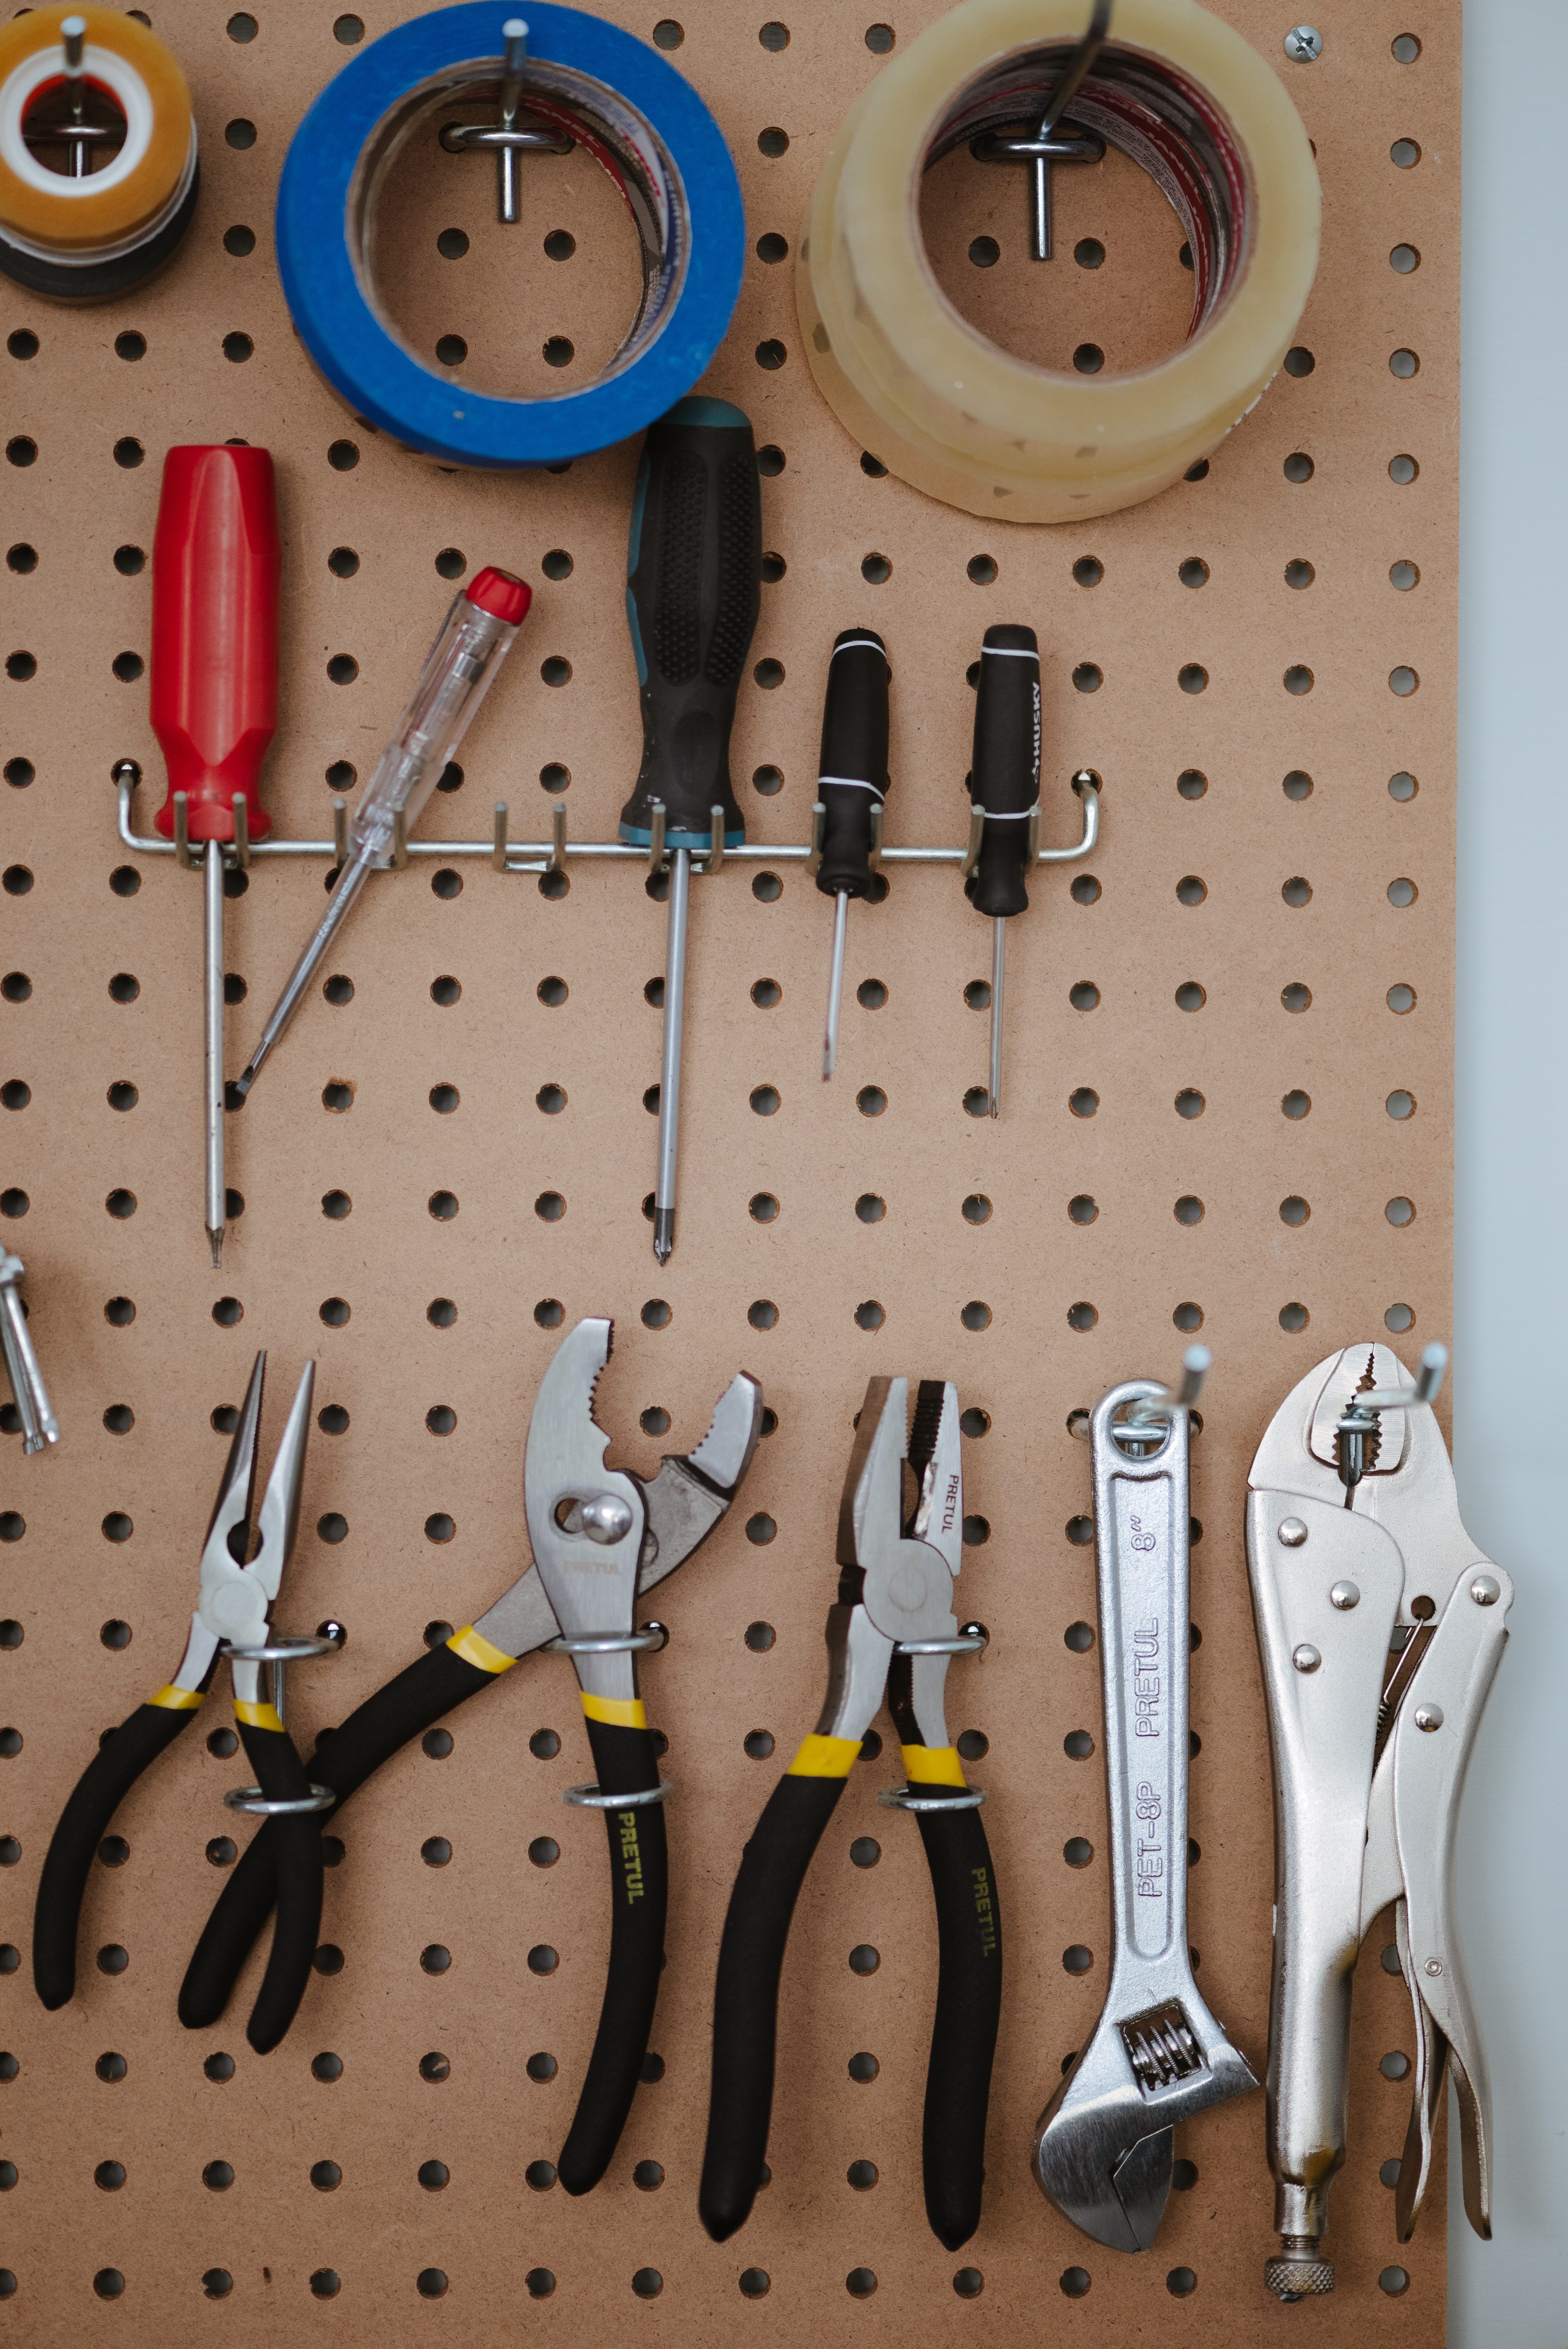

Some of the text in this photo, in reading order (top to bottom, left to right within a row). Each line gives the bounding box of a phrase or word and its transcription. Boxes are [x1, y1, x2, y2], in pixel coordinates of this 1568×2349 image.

[1136, 126, 1202, 205] JANEL
[942, 1474, 959, 1533] PRETUL
[1133, 1618, 1160, 1737] PRETUL
[618, 1812, 644, 1904] PRETUL
[1136, 1781, 1163, 1897] PET-8P
[972, 1867, 996, 1956] PRETUL
